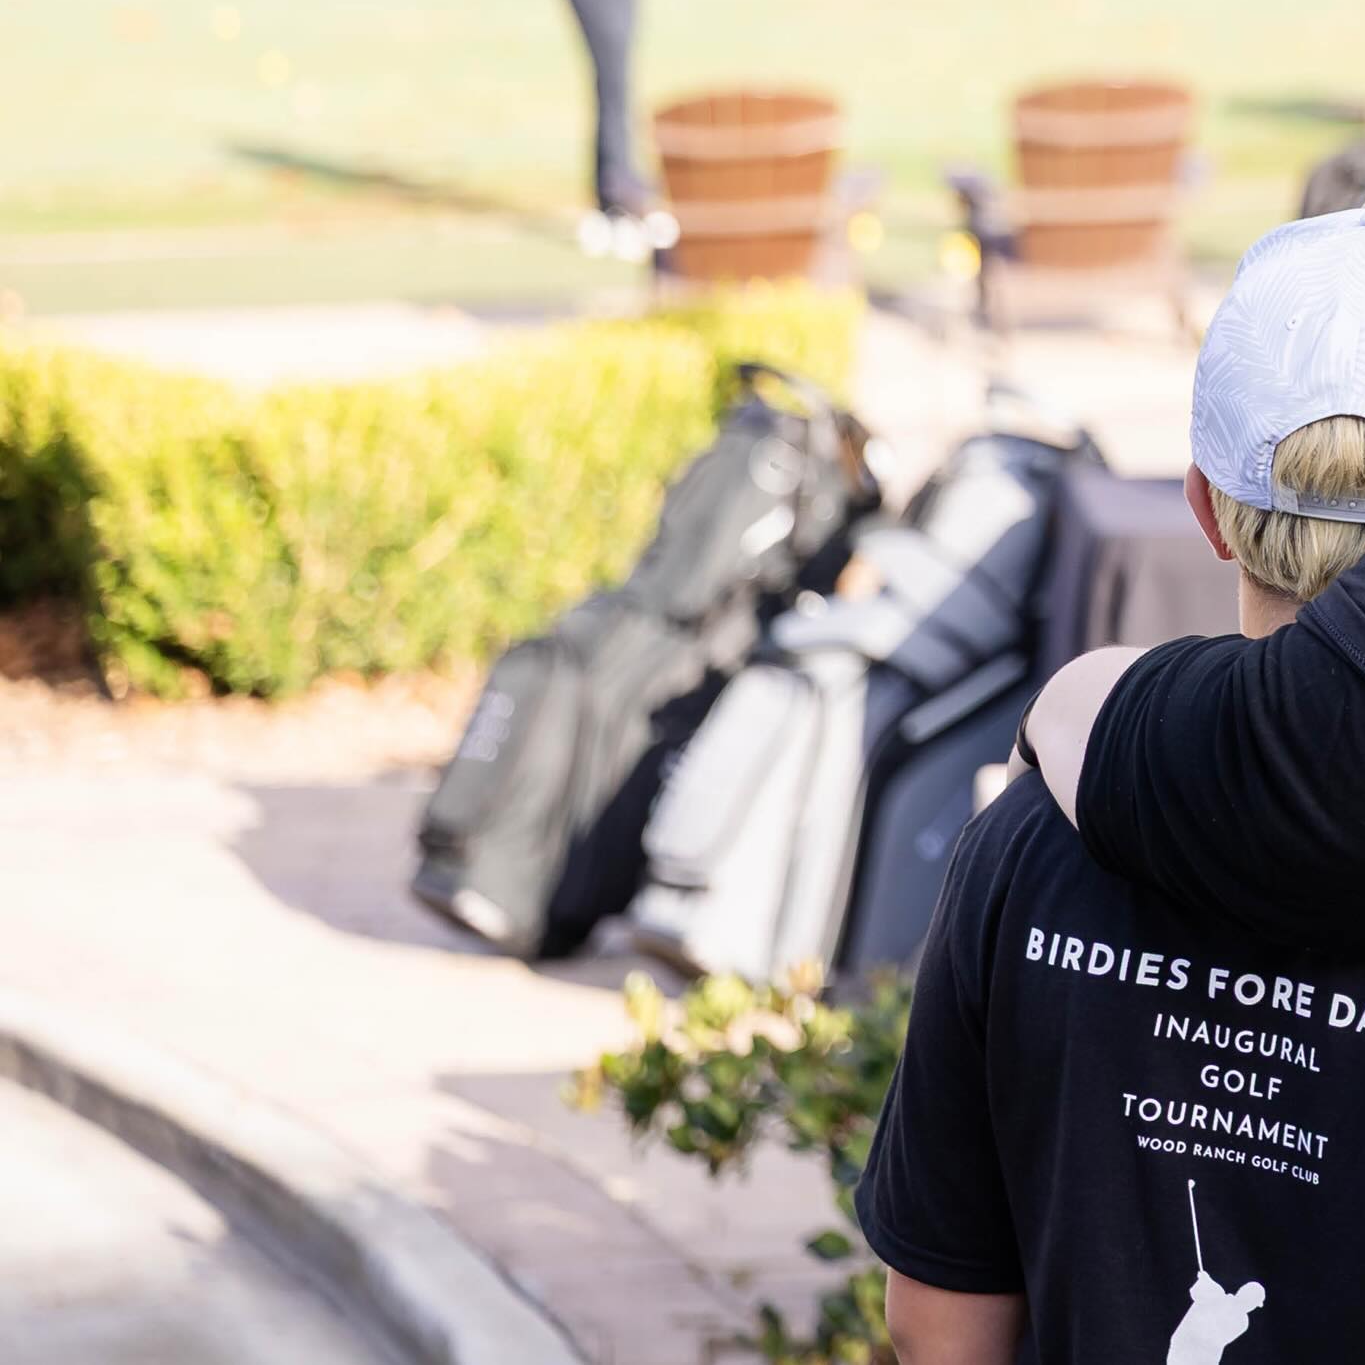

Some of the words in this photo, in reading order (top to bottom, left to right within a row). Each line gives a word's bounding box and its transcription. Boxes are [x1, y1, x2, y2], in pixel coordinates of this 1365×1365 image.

[1025, 927, 1191, 992] BIRDIES
[1208, 967, 1315, 1019] FORE
[1153, 1013, 1321, 1073] INAUGURAL
[1200, 1064, 1283, 1102] GOLF
[1122, 1092, 1329, 1160] TOURNAMENT
[1137, 1135, 1187, 1155] WOOD
[1192, 1143, 1246, 1165] RANCH
[1251, 1155, 1289, 1174] GOLF
[1291, 1165, 1320, 1186] CLUB
